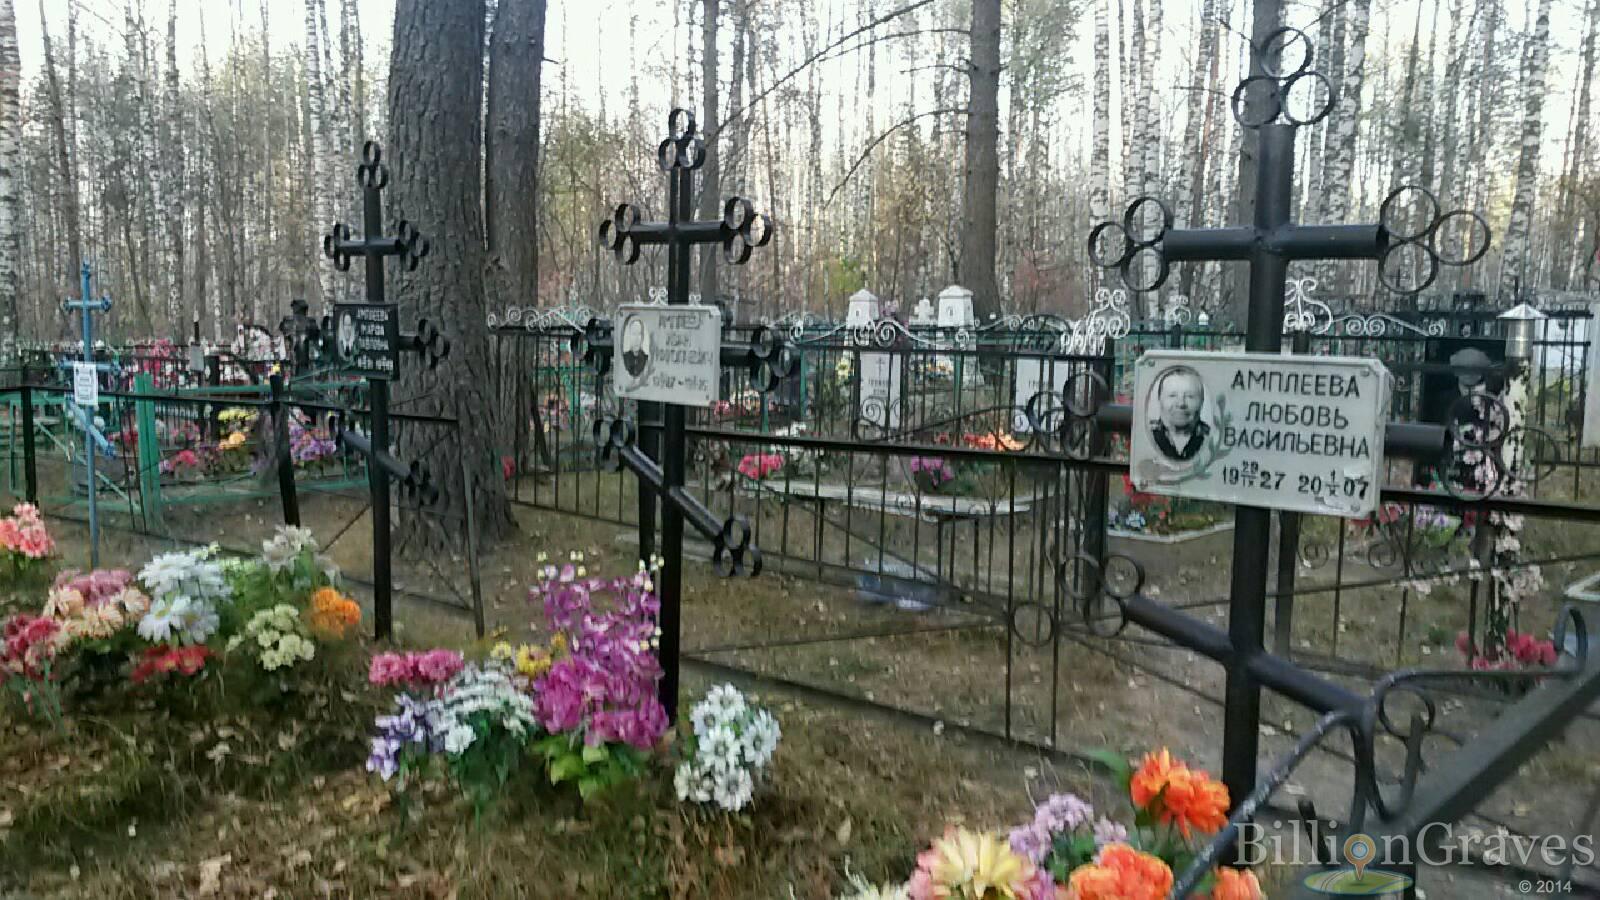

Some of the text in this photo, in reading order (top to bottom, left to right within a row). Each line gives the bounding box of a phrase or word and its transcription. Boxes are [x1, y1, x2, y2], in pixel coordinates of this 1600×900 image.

[1231, 369, 1361, 398] АМПЛЕЕВА
[1245, 401, 1349, 430] ЛЮБОВЬ
[1223, 426, 1370, 459] ВАСИЛЬЕВНА
